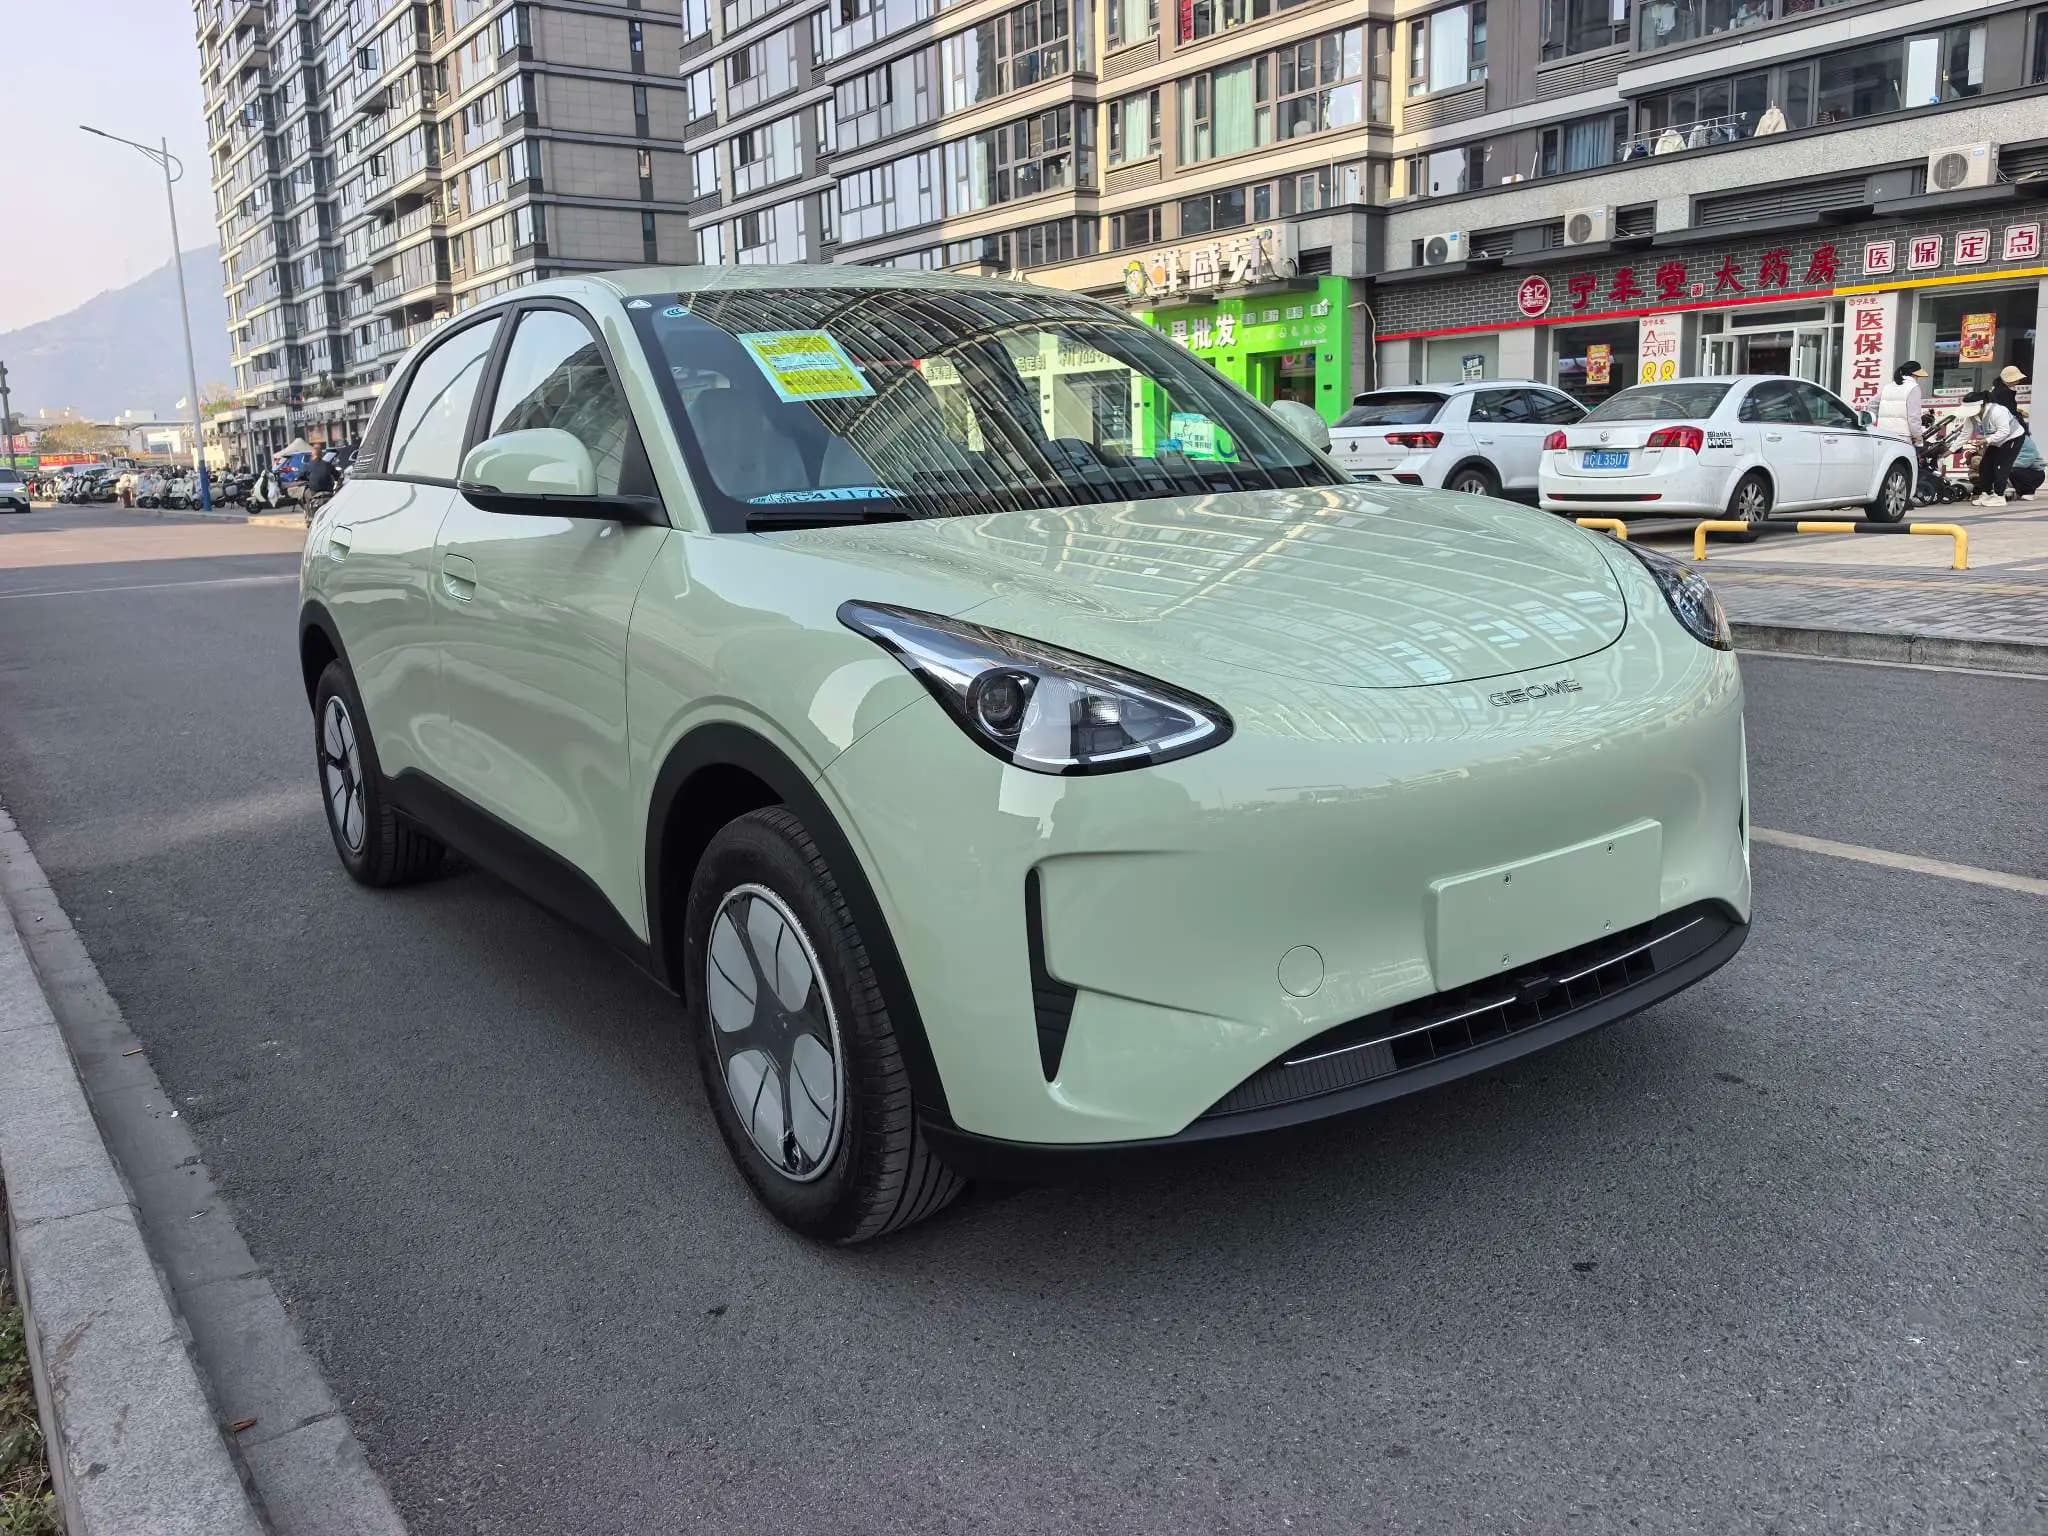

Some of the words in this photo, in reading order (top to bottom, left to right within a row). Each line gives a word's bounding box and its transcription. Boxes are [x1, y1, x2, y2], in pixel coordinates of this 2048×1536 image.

[1713, 242, 1841, 293] 大药房
[1868, 229, 2036, 269] 医保定点
[1522, 285, 1546, 298] 全亿
[1852, 307, 1884, 404] 医保定点
[1488, 679, 1583, 706] GEOME
